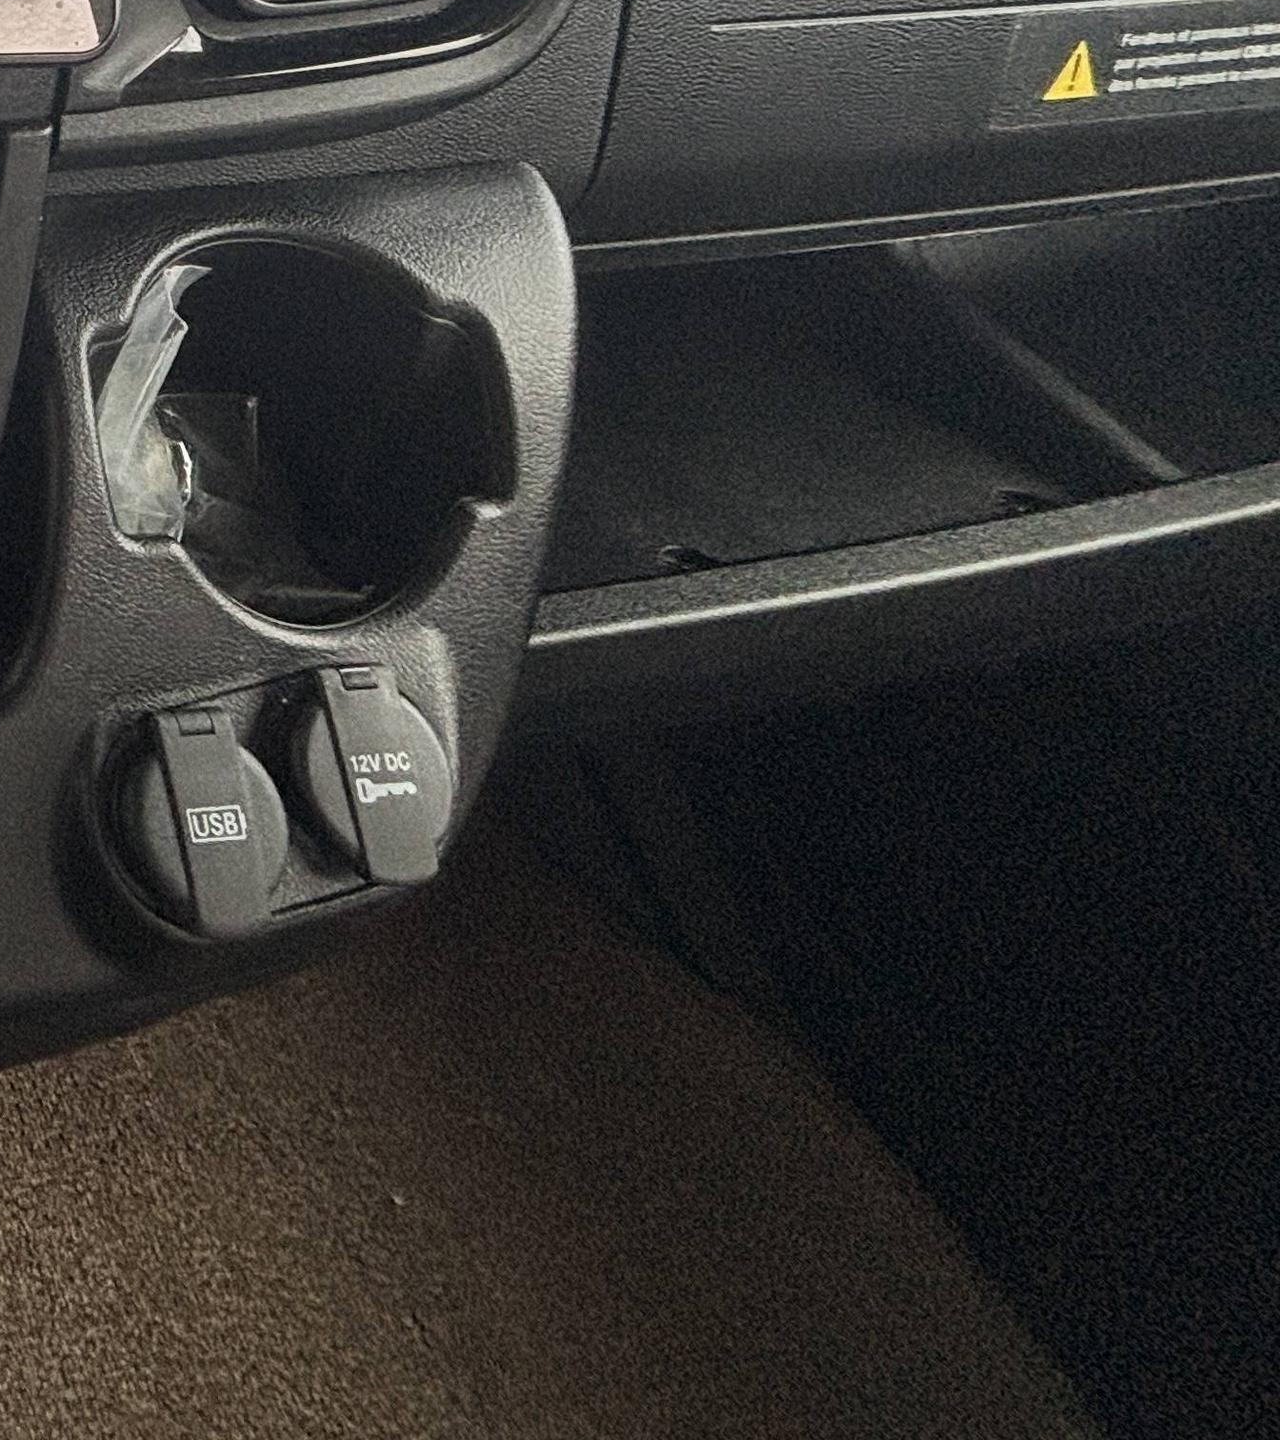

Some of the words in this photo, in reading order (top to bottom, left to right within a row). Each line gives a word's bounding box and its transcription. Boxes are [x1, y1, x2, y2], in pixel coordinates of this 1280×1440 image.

[350, 754, 381, 773] 12V
[385, 752, 412, 772] DC
[192, 812, 239, 838] USB
